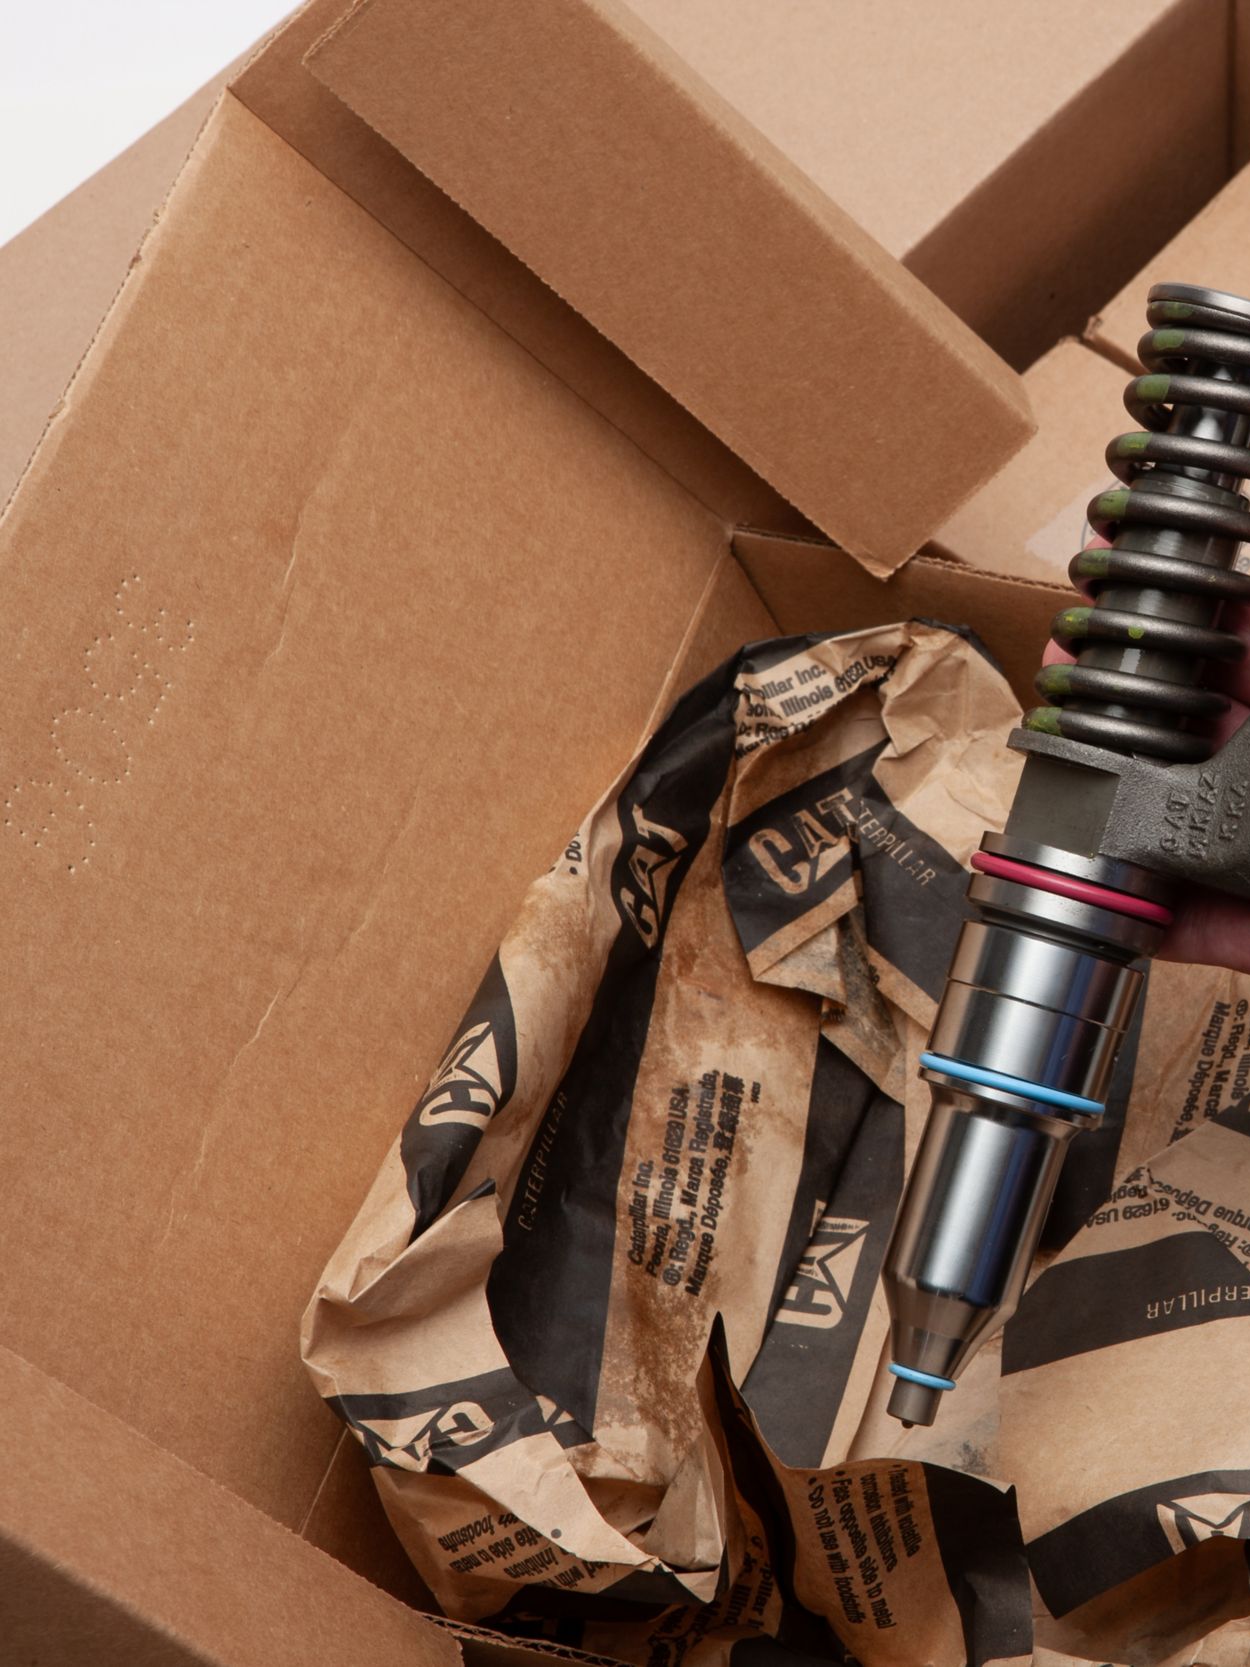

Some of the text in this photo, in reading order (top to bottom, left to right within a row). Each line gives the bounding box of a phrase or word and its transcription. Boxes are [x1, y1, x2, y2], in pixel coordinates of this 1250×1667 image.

[795, 664, 827, 686] Inc.
[780, 685, 834, 717] Illinois
[859, 807, 937, 887] TERPILLAR
[1200, 1001, 1231, 1057] Marque
[668, 1086, 690, 1120] USA
[1203, 1069, 1230, 1121] Marca
[651, 1166, 678, 1219] Illinois
[680, 1156, 704, 1207] Marca
[626, 1159, 657, 1264] Caterpillar Inc.
[1121, 1197, 1170, 1220] 61629
[644, 1223, 671, 1277] Peoria,
[684, 1232, 713, 1296] Marque
[813, 1507, 835, 1530] not
[819, 1529, 839, 1550] use
[826, 1551, 849, 1574] with
[858, 1555, 878, 1585] side
[834, 1576, 866, 1624] foodstuffs
[865, 1582, 883, 1599] to
[870, 1597, 896, 1629] metal
